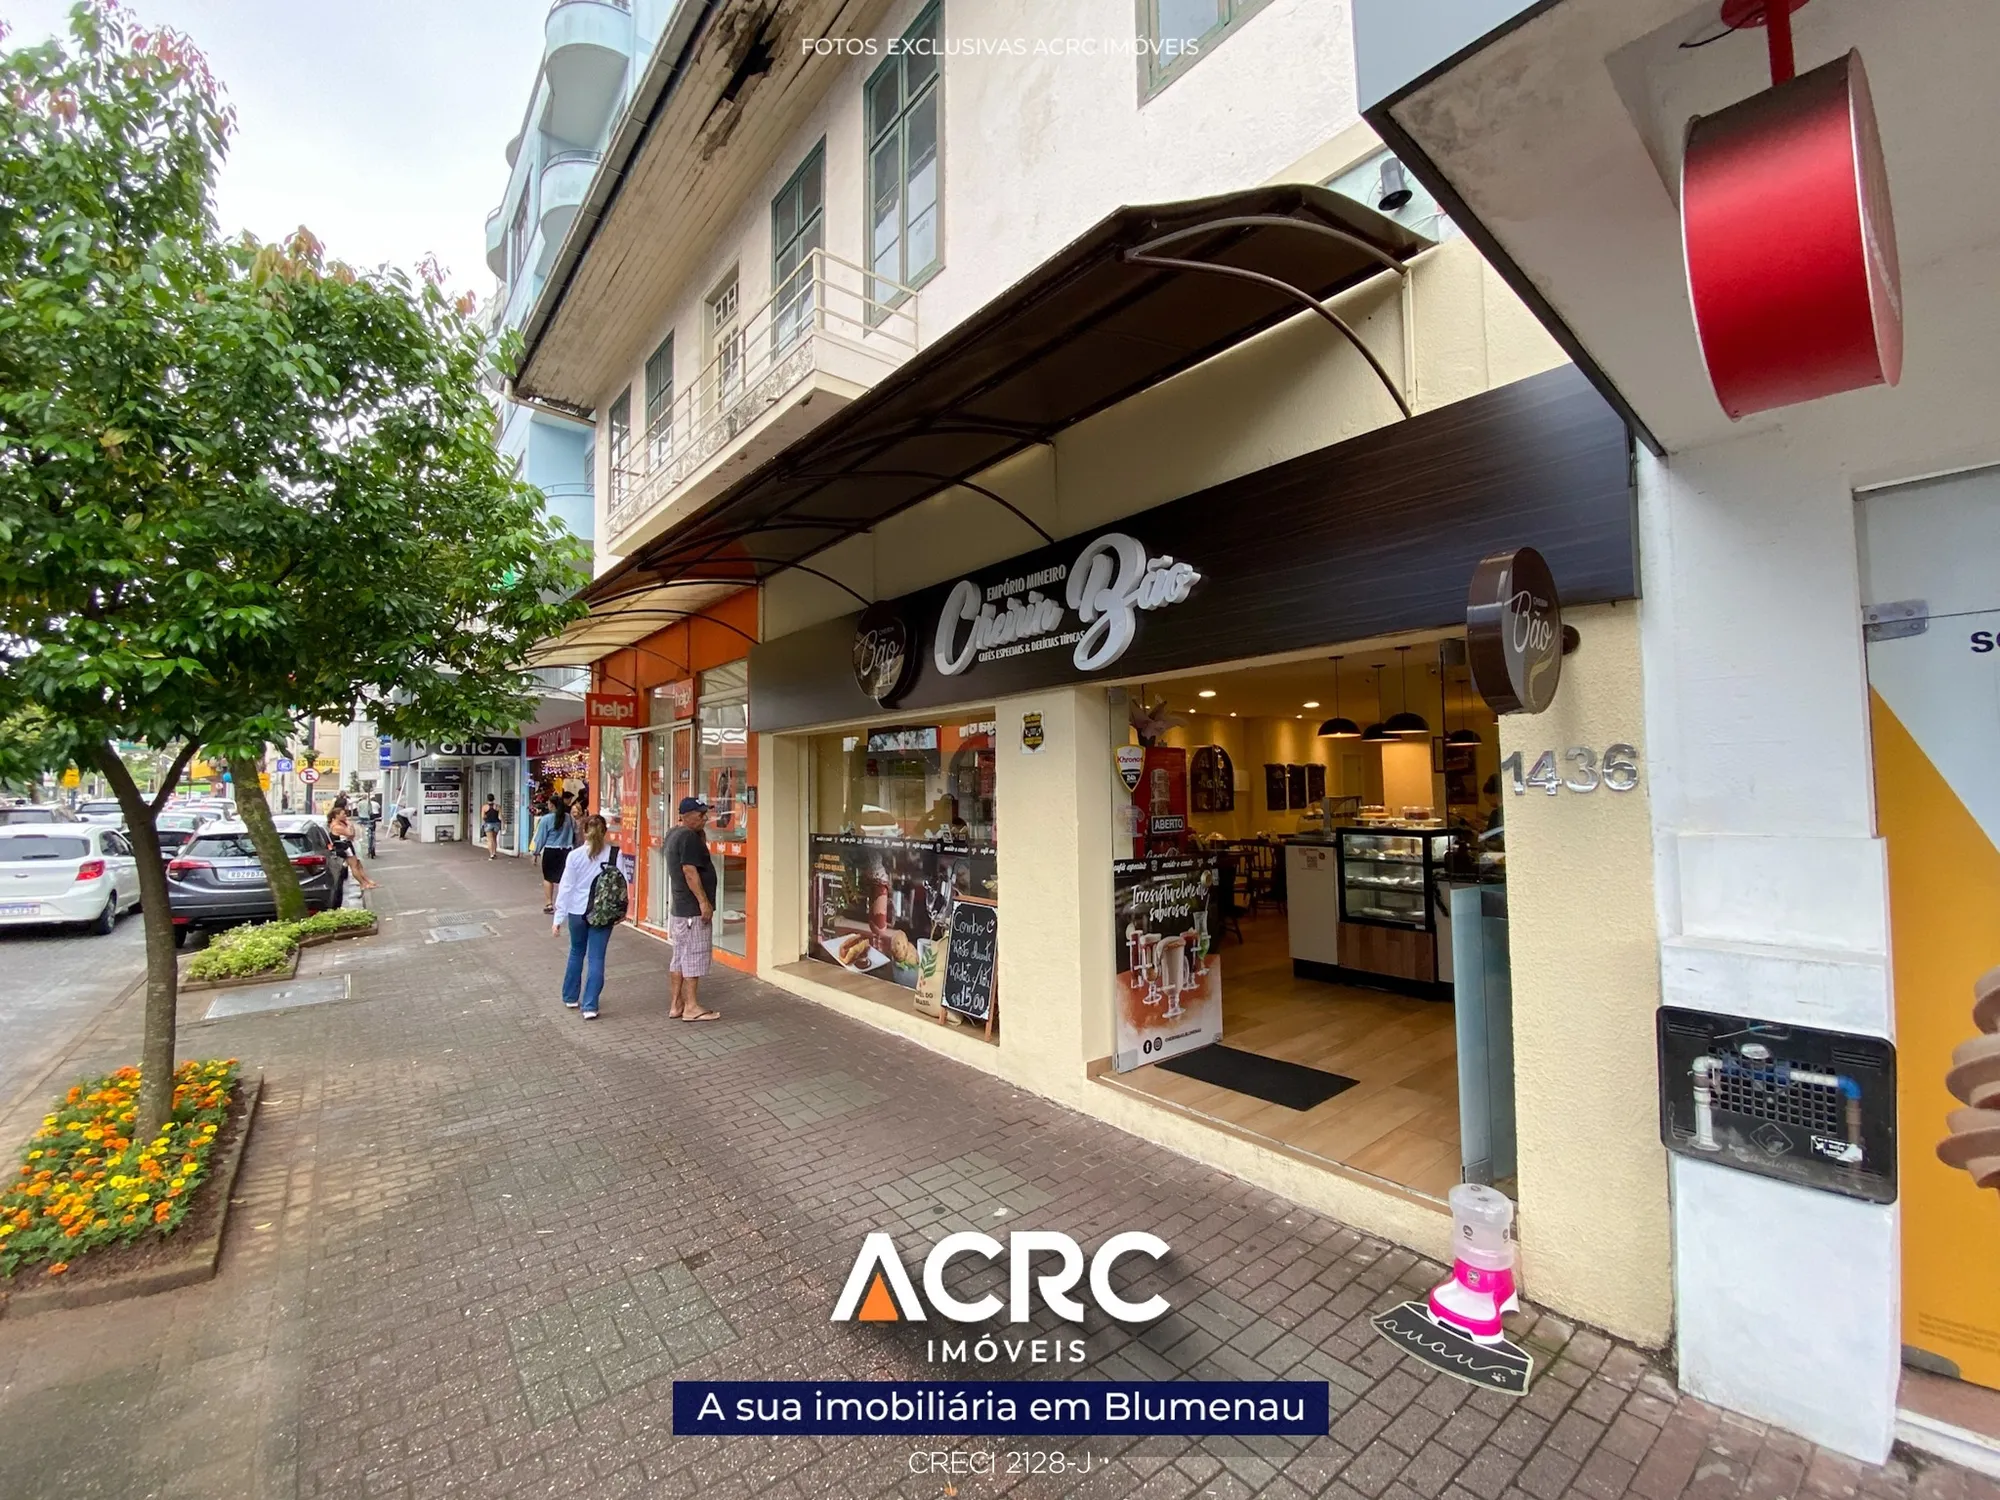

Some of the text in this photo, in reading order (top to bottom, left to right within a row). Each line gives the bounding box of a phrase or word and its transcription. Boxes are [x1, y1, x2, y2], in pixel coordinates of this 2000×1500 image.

[987, 564, 1066, 601] EMPÓRIO MINEIRO
[933, 580, 1064, 675] Cheirin
[1503, 590, 1553, 653] Bão
[978, 629, 1085, 662] CAFÉS ESPECIAIS & DELÍCIAS TÍPICAS
[675, 687, 692, 709] help!
[591, 700, 634, 720] help!
[365, 741, 372, 750] E
[1117, 754, 1143, 764] Khronos
[1502, 744, 1639, 796] 1436
[1155, 818, 1183, 830] ABERTO
[954, 911, 985, 936] Combo
[1149, 903, 1191, 923] saborosas
